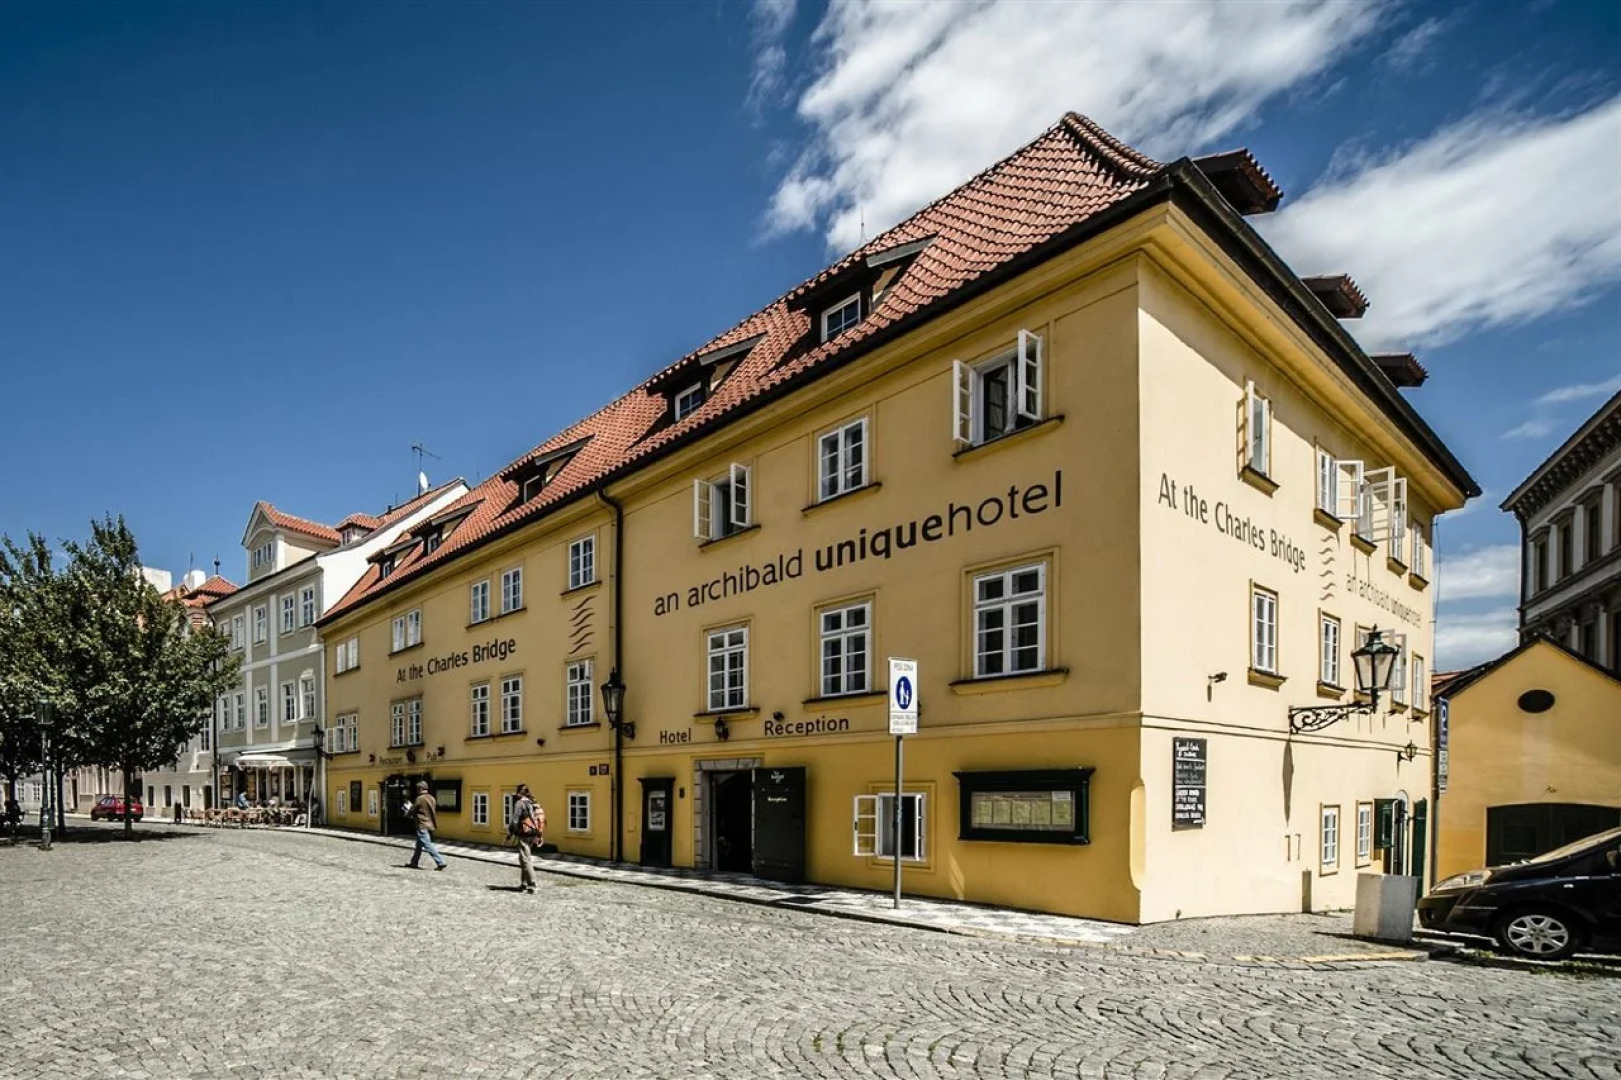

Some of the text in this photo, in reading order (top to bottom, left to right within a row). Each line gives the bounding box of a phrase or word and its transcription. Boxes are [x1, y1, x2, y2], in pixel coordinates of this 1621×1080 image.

[654, 470, 1062, 617] an archibald uniquehotel
[1158, 473, 1306, 574] At the Charles Bridge
[396, 638, 516, 684] At the Charles Bridge
[660, 727, 691, 744] Hotel
[764, 715, 849, 736] Reception
